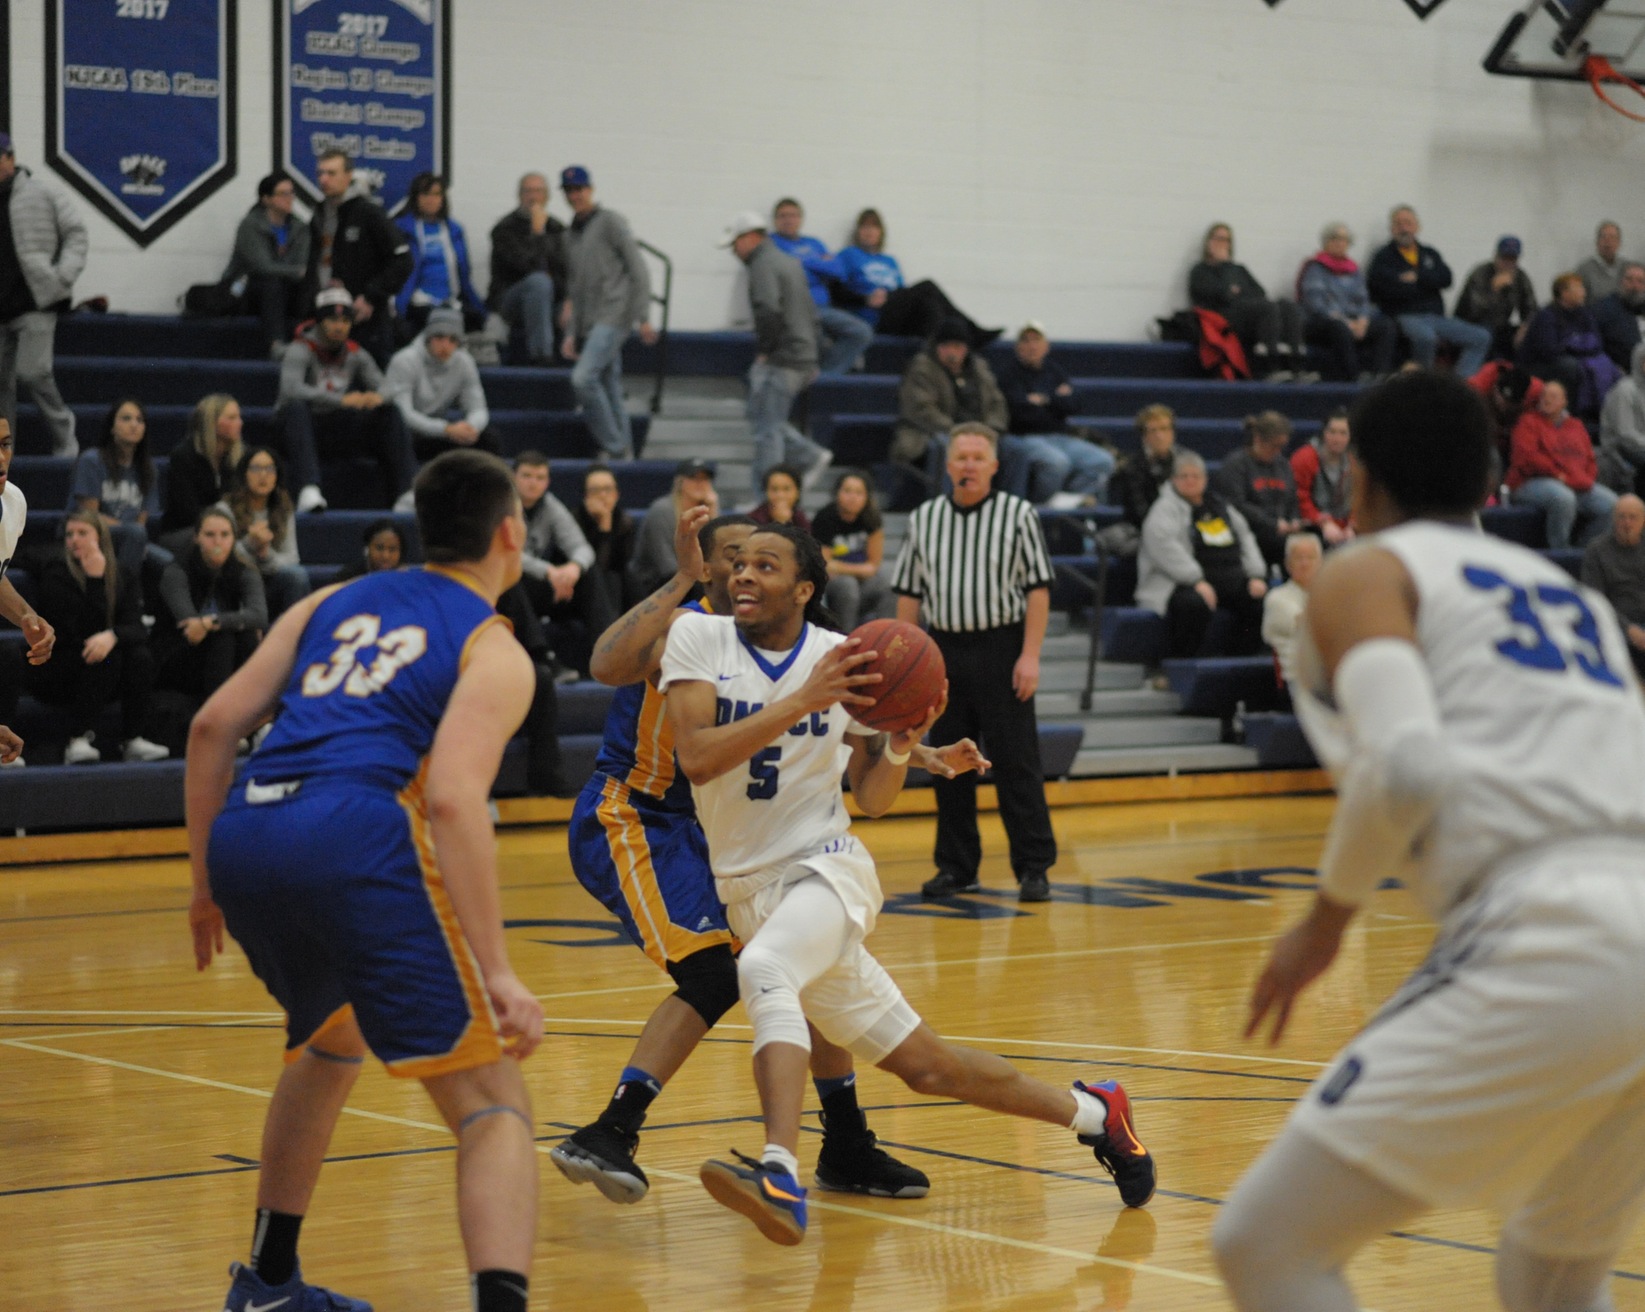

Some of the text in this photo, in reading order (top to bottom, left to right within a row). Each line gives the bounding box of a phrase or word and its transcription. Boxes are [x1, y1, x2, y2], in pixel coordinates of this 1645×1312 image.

[115, 0, 170, 20] 2017
[338, 13, 389, 37] 2017
[1463, 563, 1626, 688] 33
[302, 613, 427, 698] 33
[746, 746, 782, 801] 5
